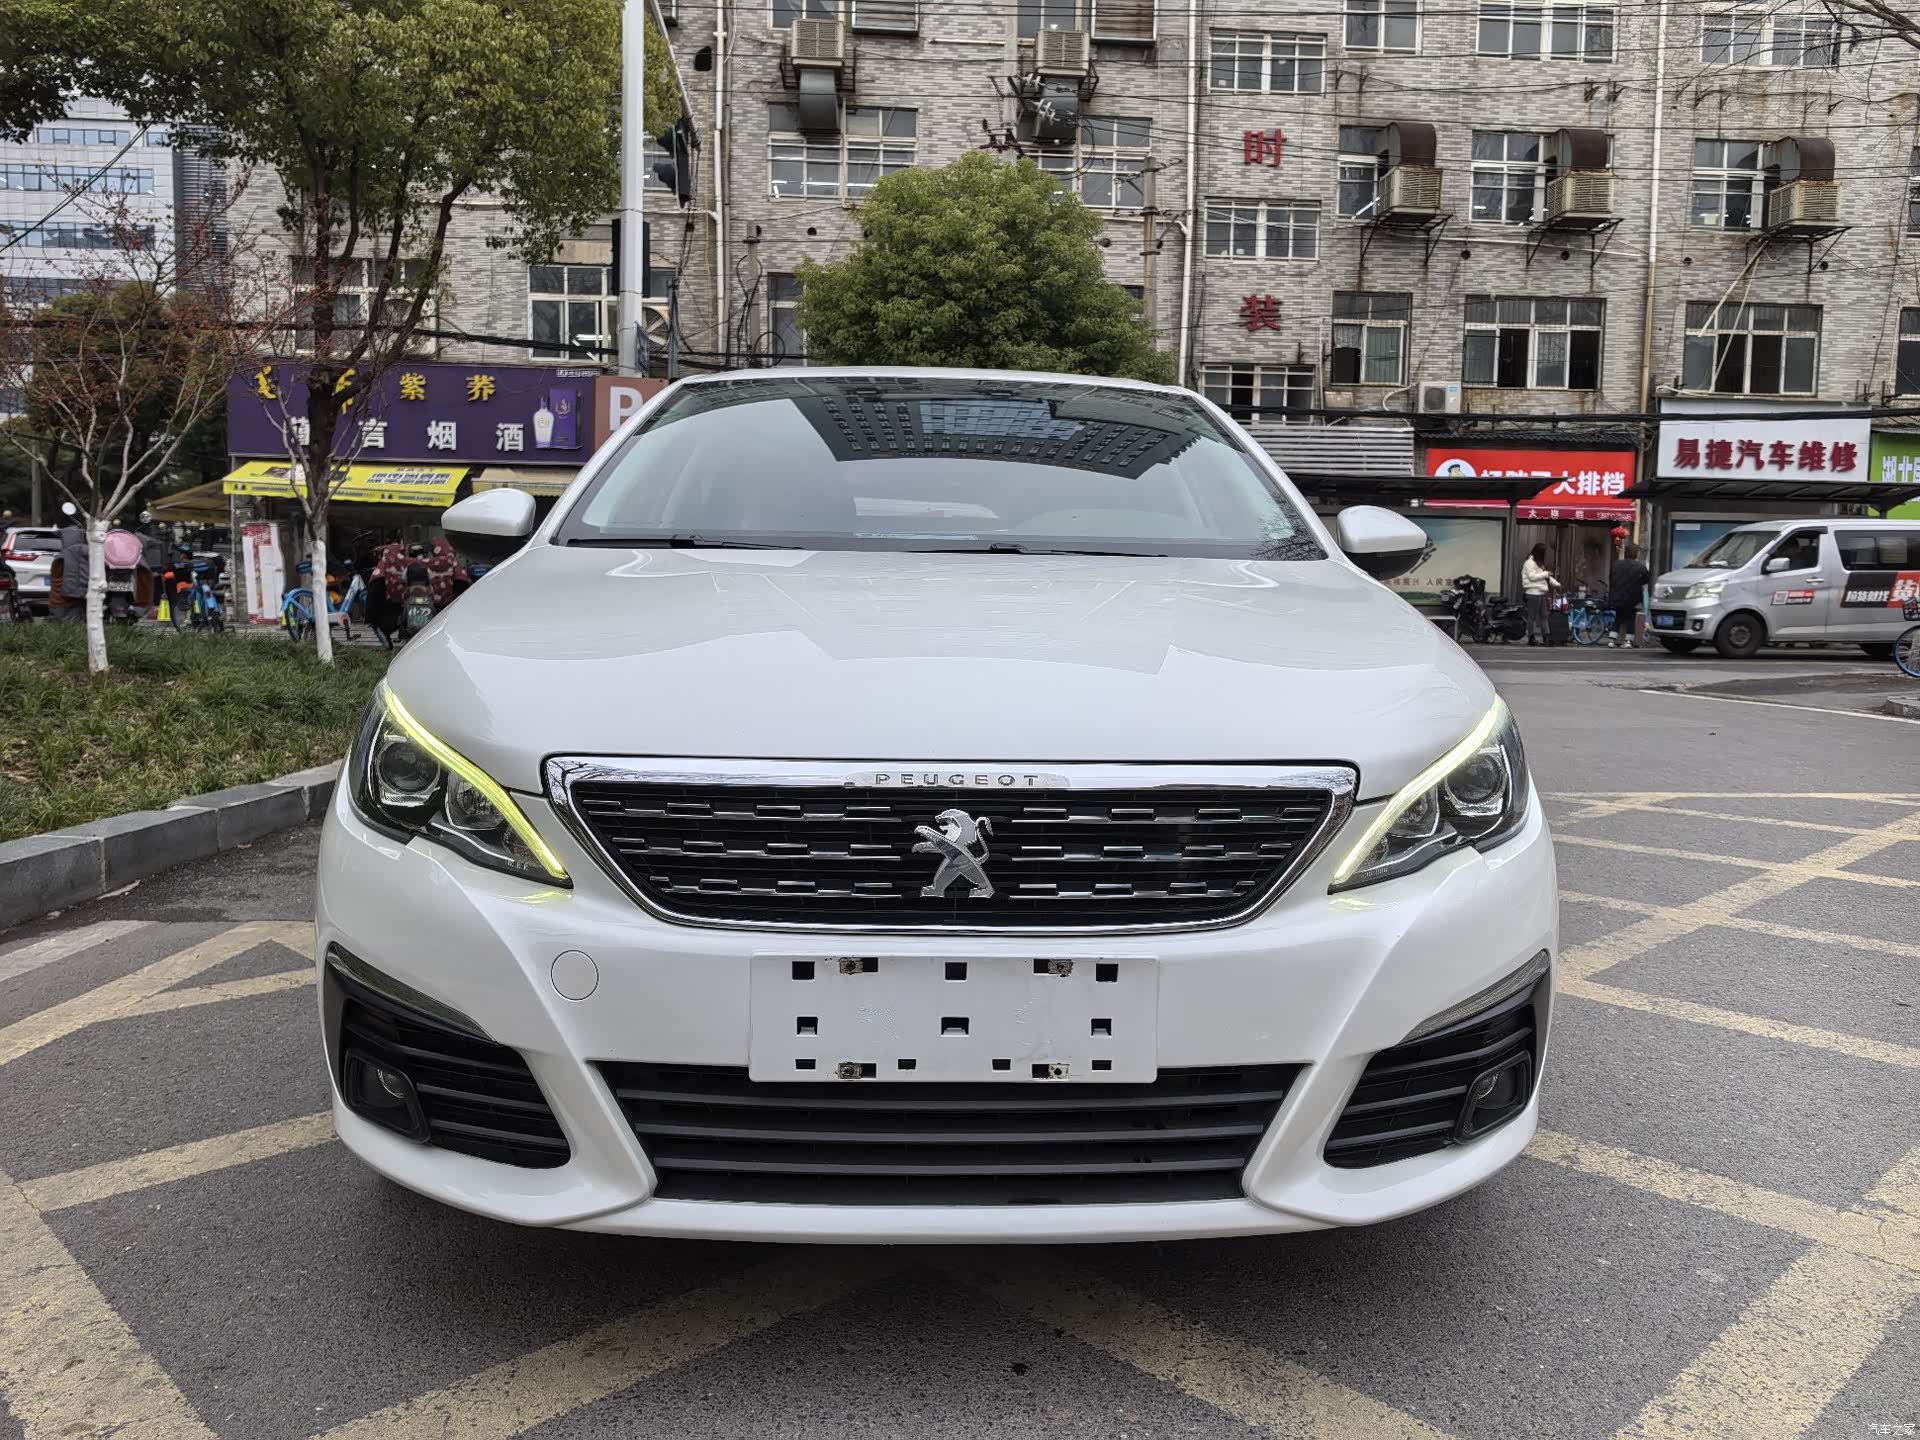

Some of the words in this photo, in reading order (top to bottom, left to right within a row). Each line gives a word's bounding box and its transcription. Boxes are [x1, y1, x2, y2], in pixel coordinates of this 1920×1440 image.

[609, 386, 644, 431] P
[1674, 438, 1858, 472] 易捷汽车维修
[875, 773, 1039, 786] PEUGEOT
